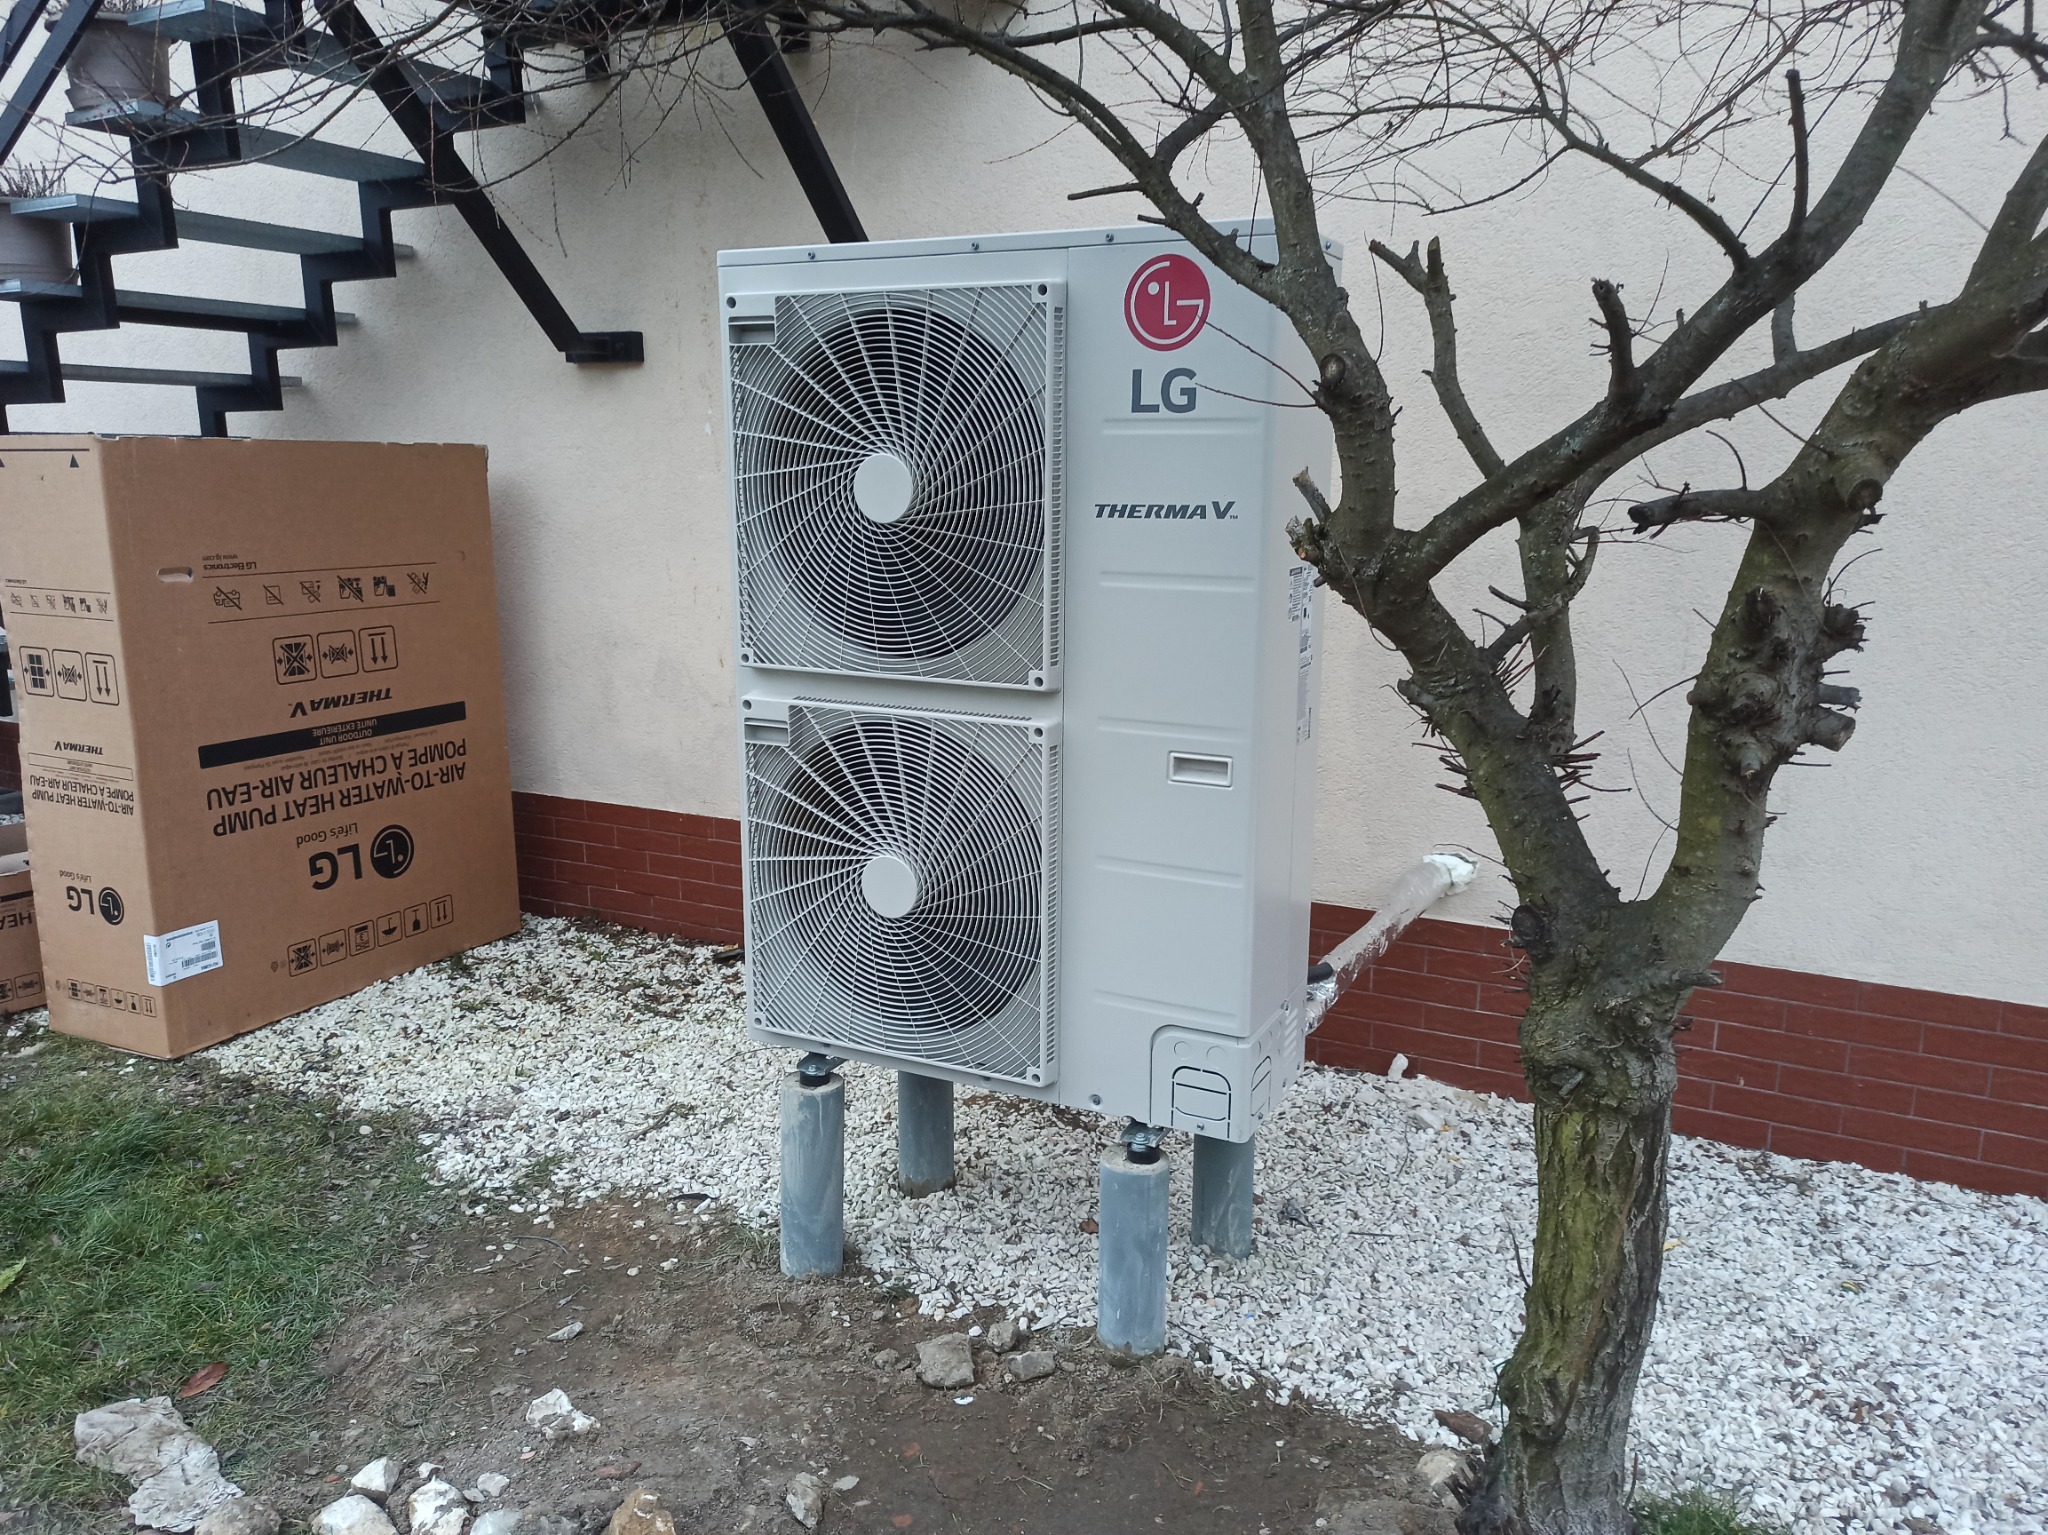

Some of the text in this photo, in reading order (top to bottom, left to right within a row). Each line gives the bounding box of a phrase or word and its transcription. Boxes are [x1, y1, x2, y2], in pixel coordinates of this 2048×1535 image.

[1131, 367, 1198, 413] LG
[1094, 503, 1207, 520] THERMA
[203, 561, 257, 570] LG Electronics
[310, 688, 392, 712] THERMA
[319, 735, 336, 746] UNIT
[338, 728, 372, 742] OUTDOOR
[62, 742, 104, 756] THERMA
[408, 738, 466, 768] POMPE
[298, 755, 387, 791] CHALEUR
[390, 751, 404, 776] À
[30, 774, 60, 790] AIR-EAU
[62, 780, 98, 796] CHALEUR
[106, 786, 134, 802] POMPE
[206, 773, 295, 810] AIR-EAU
[338, 762, 466, 808] AIR-TO-WATER
[32, 789, 134, 816] AIR-TO-WATER HEAT PUMP
[282, 792, 335, 822] HEAT
[213, 804, 277, 837] PUMP
[296, 822, 358, 848] Life's Good
[59, 870, 75, 880] Good
[308, 842, 362, 890] LG
[66, 886, 95, 915] LG
